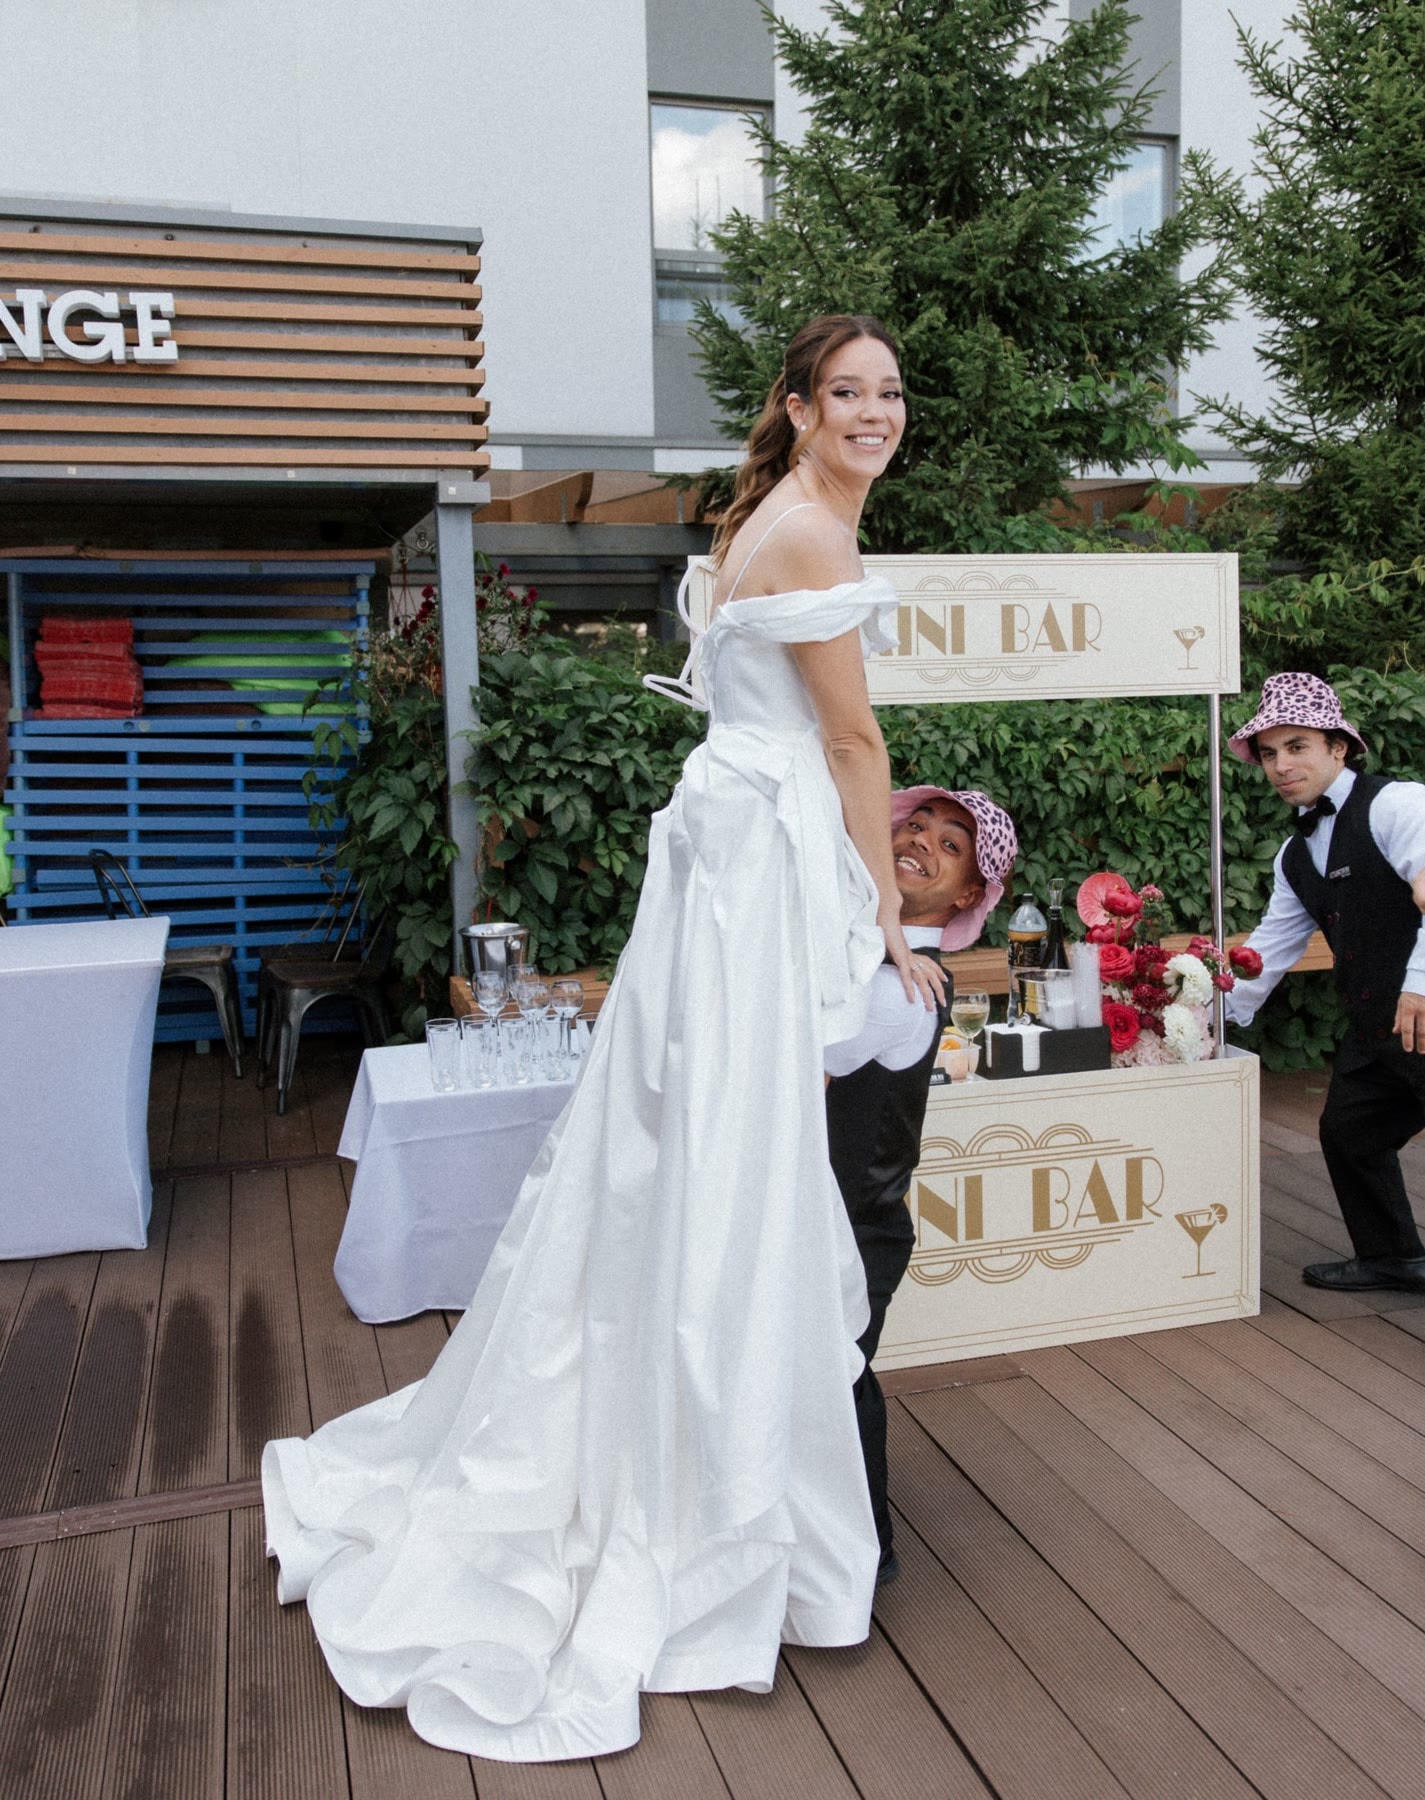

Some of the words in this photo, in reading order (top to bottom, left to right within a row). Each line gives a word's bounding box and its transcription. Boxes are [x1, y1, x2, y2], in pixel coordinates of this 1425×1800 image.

[0, 289, 178, 364] NGE
[879, 604, 965, 656] INI
[1001, 601, 1102, 654] BAR
[903, 1174, 984, 1247] NI
[1032, 1156, 1165, 1233] BAR
